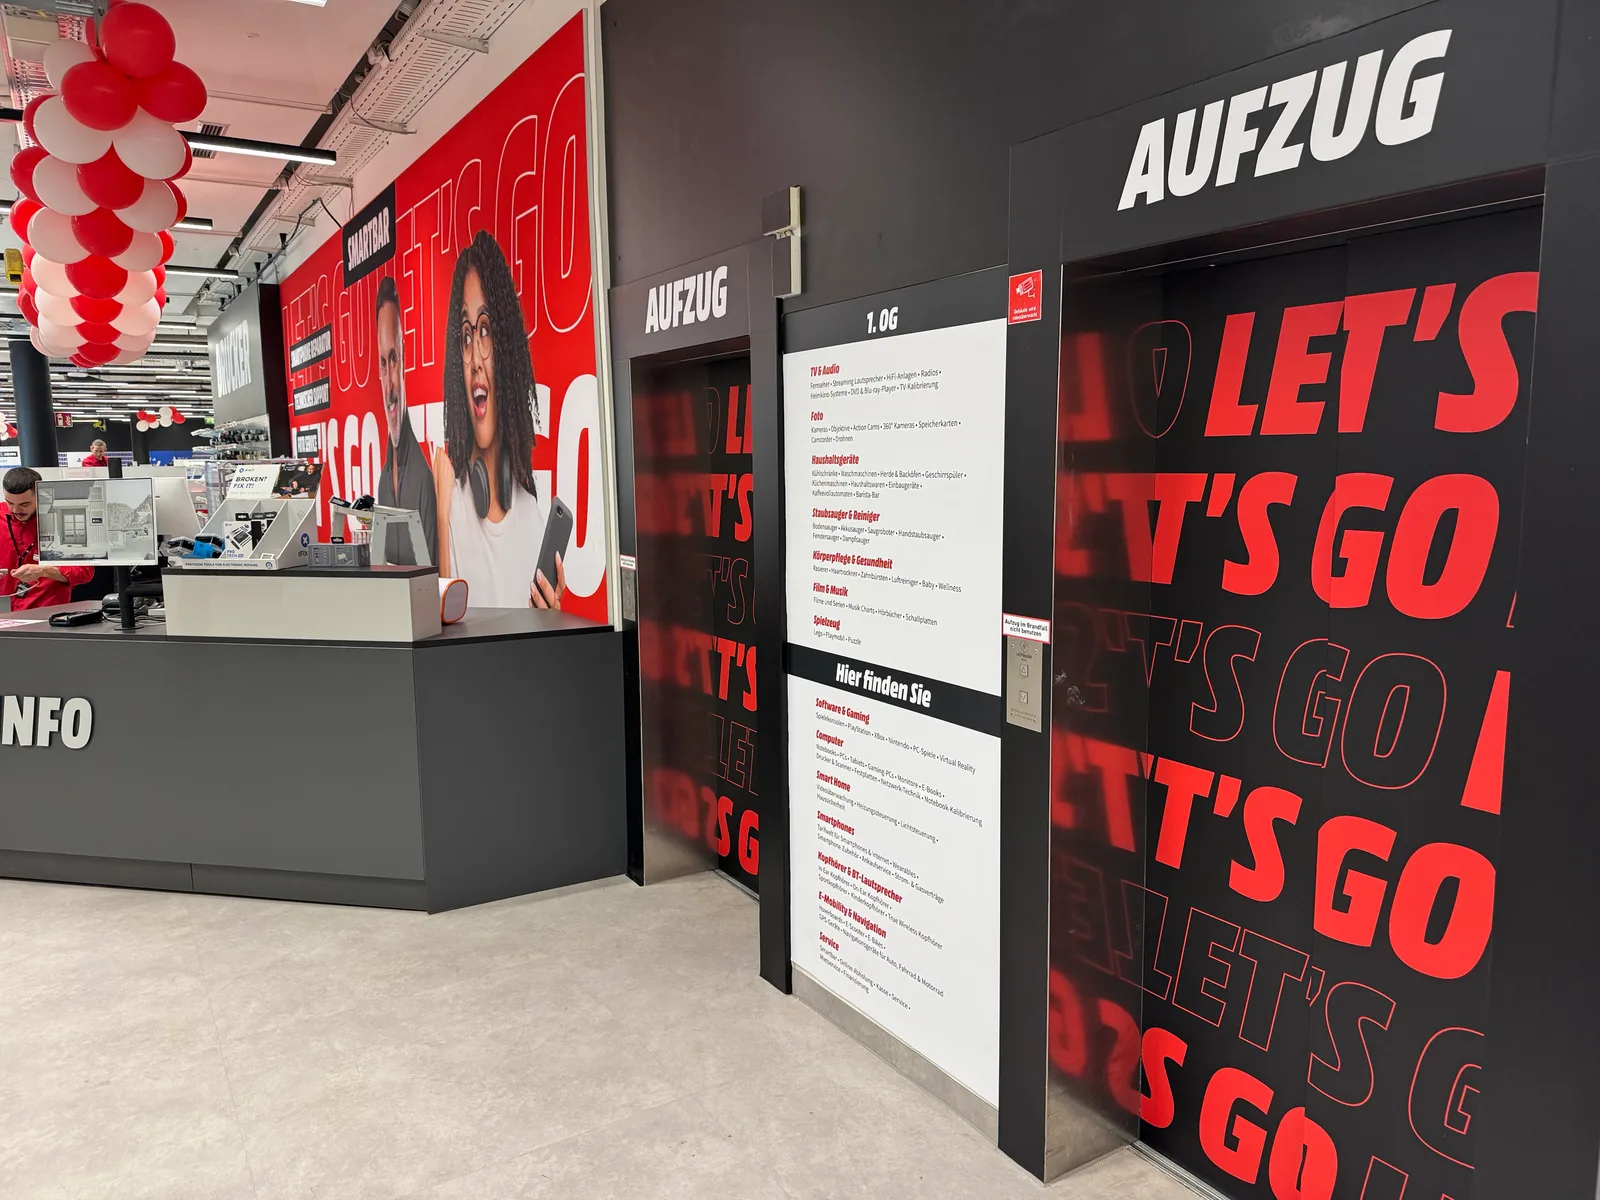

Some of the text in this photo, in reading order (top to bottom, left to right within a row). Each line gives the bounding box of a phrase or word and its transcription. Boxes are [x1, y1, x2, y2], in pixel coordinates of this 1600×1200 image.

[1116, 29, 1452, 212] AUFZUG
[347, 206, 390, 271] SMARTBAR
[645, 266, 728, 334] AUFZUG
[867, 306, 898, 334] 1. OG
[216, 319, 251, 398] DRUCKER
[1204, 271, 1539, 436] LET'S
[811, 364, 839, 377] TV & Audio
[855, 375, 883, 384] Lautsprecher
[921, 369, 938, 377] Radios
[811, 411, 823, 421] Foto
[831, 425, 850, 433] Objektive
[812, 454, 859, 466] Haushaltsgeräte
[899, 470, 921, 478] Backöfen
[889, 481, 919, 490] Einbaugeräte
[812, 508, 880, 523] Staubsauger & Reiniger
[813, 523, 837, 532] Bodensauger
[841, 525, 864, 534] Akkusauger
[868, 527, 895, 536] Saugroboter
[813, 533, 870, 545] Fenstersauger Dampfsauger
[1311, 472, 1500, 619] GO
[813, 551, 893, 569] Körperpflege & Gesundheit
[813, 583, 848, 597] Film & Musik
[831, 568, 857, 576] Haartrockner
[861, 572, 888, 581] Zahnbürsten
[892, 576, 918, 587] Luftreiniger
[922, 580, 934, 589] Baby
[938, 583, 961, 592] Wellness
[814, 615, 840, 631] Spielzeug
[833, 600, 845, 608] Serien
[861, 605, 875, 614] Charts
[878, 609, 902, 619] Hörbücher
[906, 614, 937, 625] Schallplatten
[1005, 618, 1020, 628] Aufzug
[1027, 622, 1048, 631] Brandfall
[1021, 628, 1042, 637] benutzen
[814, 629, 861, 645] Lego Playmobil Puzzle
[836, 663, 931, 707] Hier finden Sie
[816, 698, 869, 723] Software & Gaming
[1272, 638, 1447, 790] GO
[1, 695, 93, 749] NFO
[816, 730, 844, 747] Computer
[817, 770, 850, 792] Smart Home
[817, 811, 854, 835] Smartphones
[818, 851, 902, 903] Kopfhörer & BT-Lautsprecher
[1313, 815, 1496, 980] GO
[819, 891, 886, 938] E-Mobility & Navigation
[820, 932, 839, 951] Service
[1200, 1067, 1338, 1200] GO
